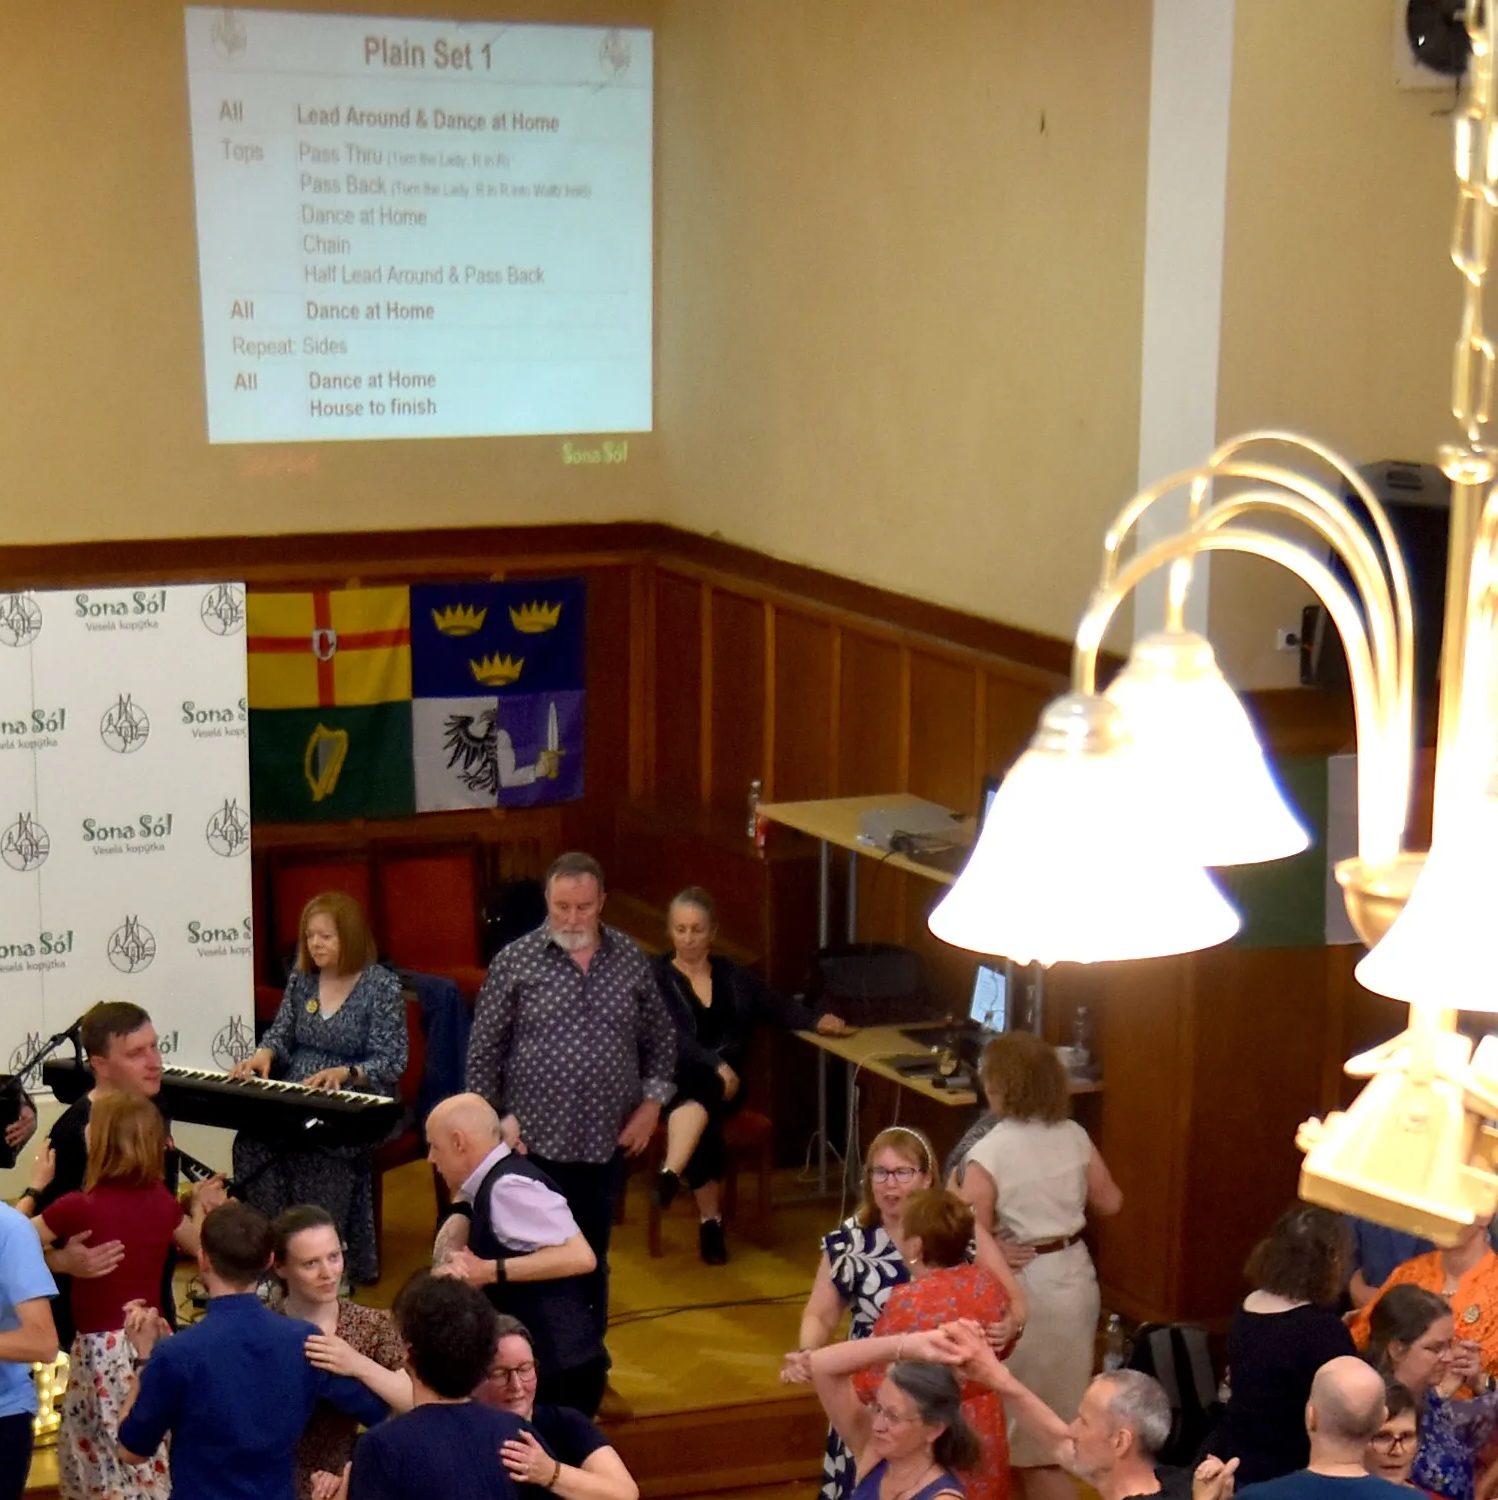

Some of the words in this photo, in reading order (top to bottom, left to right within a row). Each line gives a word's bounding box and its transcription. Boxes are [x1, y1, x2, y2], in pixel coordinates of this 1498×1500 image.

[364, 36, 425, 68] Plain
[434, 41, 473, 70] Set
[481, 43, 492, 70] 1
[219, 102, 244, 122] All
[297, 105, 340, 125] Lead
[346, 106, 410, 128] Around
[416, 110, 427, 128] &
[432, 110, 488, 132] Dance
[492, 113, 507, 131] at
[511, 113, 559, 133] Home
[221, 139, 264, 163] Tops
[299, 143, 339, 164] Pass
[346, 145, 383, 165] Thru
[301, 175, 340, 195] Pass
[346, 176, 386, 196] Back
[302, 204, 354, 225] Dance
[360, 206, 374, 225] at
[380, 207, 427, 227] Home
[303, 235, 351, 255] Chain
[305, 265, 337, 285] Half
[342, 266, 382, 285] Lead
[387, 266, 443, 285] Around
[449, 267, 459, 284] &
[465, 266, 502, 285] Pass
[507, 266, 545, 285] Back
[231, 301, 255, 320] All
[306, 302, 359, 321] Dance
[365, 303, 381, 320] at
[386, 302, 435, 321] Home
[302, 337, 348, 357] Sides
[234, 373, 258, 391] All
[309, 372, 362, 391] Dance
[368, 372, 383, 390] at
[388, 371, 436, 390] Home
[310, 399, 364, 419] House
[370, 399, 385, 417] to
[390, 396, 437, 416] finish
[75, 593, 129, 618] Sona
[132, 590, 167, 614] Sól
[31, 708, 66, 733] Sól
[181, 700, 234, 724] Sona
[82, 818, 136, 842] Sona
[139, 813, 174, 837] Sól
[40, 930, 74, 955] Sól
[188, 920, 239, 944] Sona
